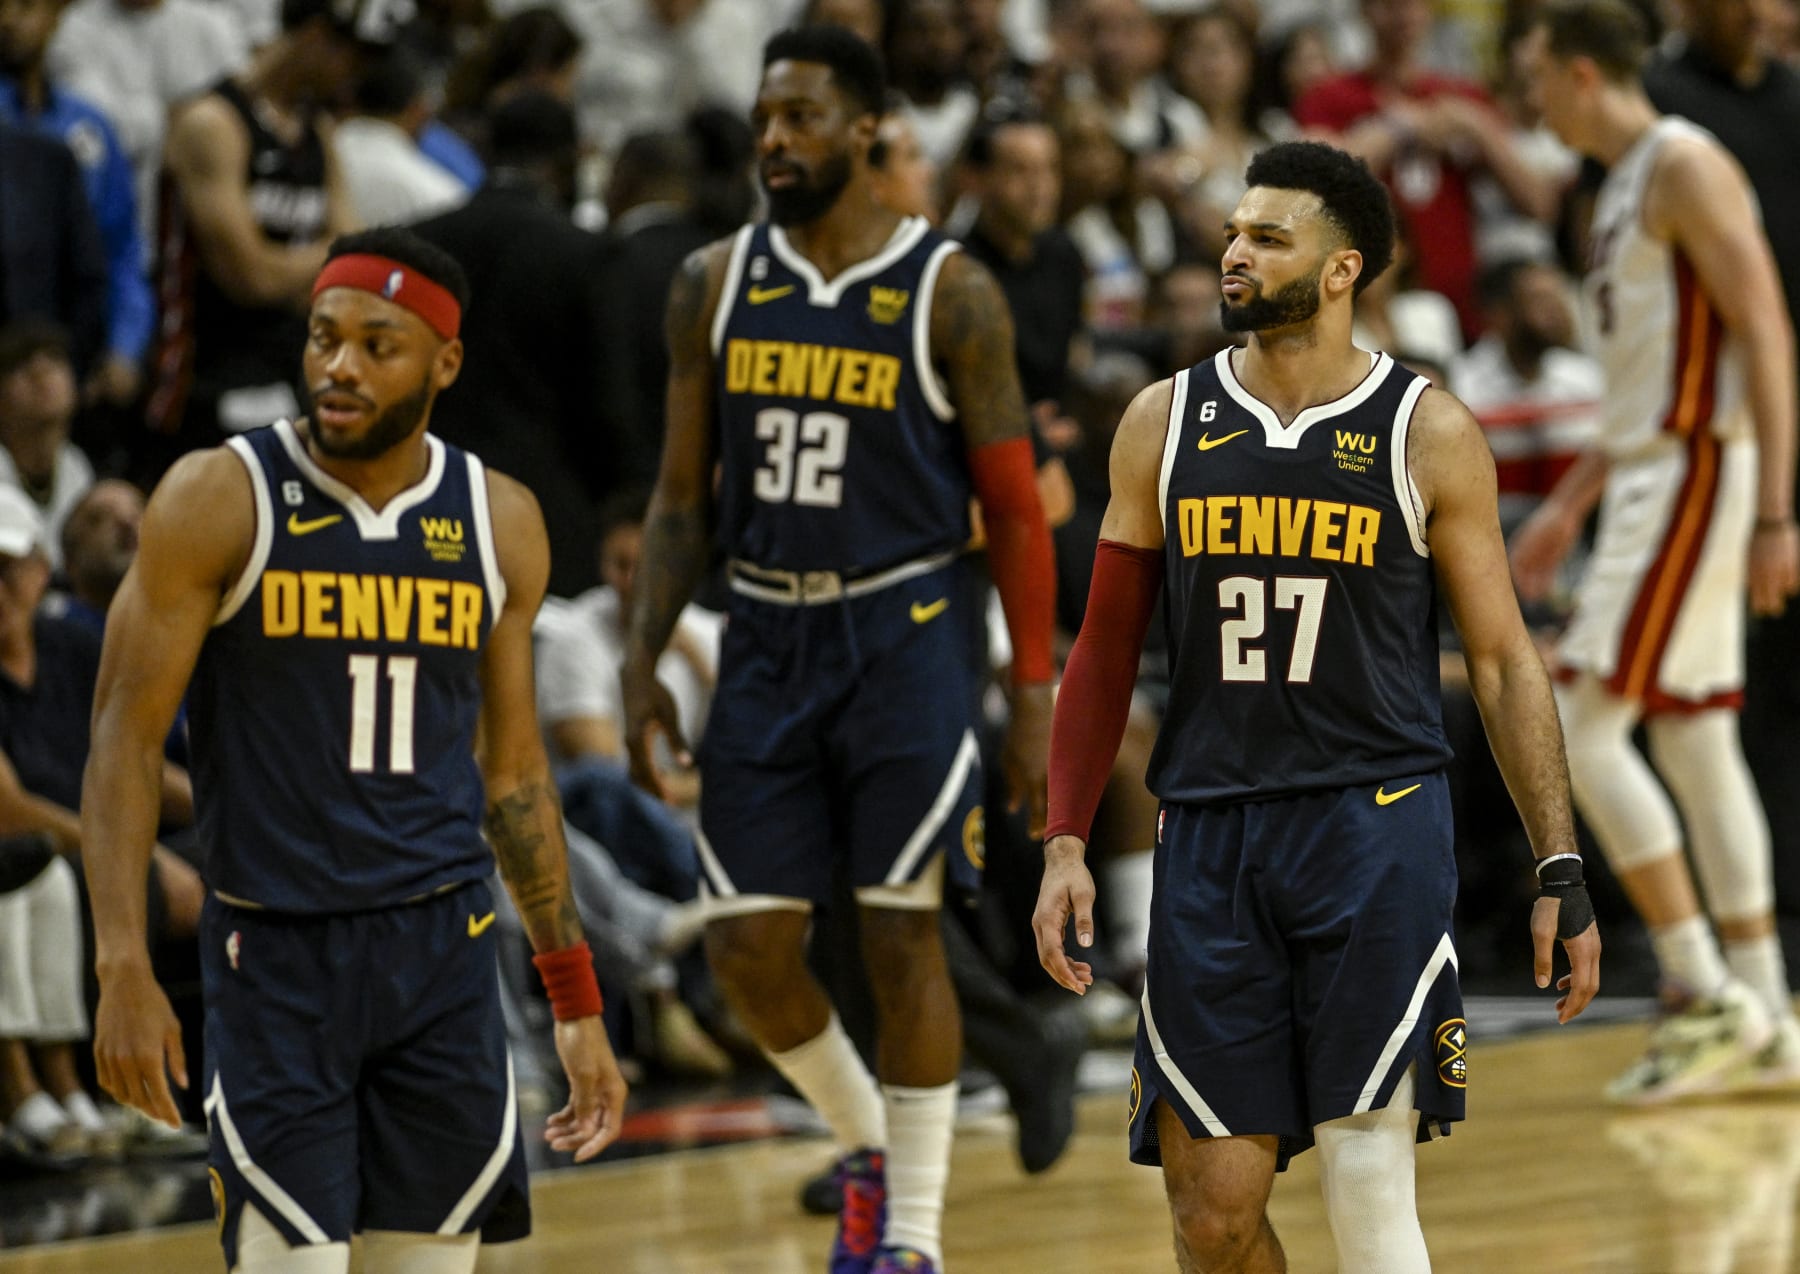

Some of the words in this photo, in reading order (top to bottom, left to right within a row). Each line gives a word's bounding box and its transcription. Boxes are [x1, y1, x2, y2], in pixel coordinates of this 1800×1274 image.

[726, 337, 902, 411] DENVER
[1200, 401, 1217, 422] 6
[754, 407, 850, 509] 32
[1333, 449, 1374, 465] Western
[1335, 429, 1377, 454] WU
[1338, 460, 1366, 473] Union
[282, 480, 304, 506] 6
[420, 516, 464, 542] WU
[1178, 495, 1382, 567] DENVER
[262, 569, 484, 650] DENVER
[1218, 575, 1329, 684] 27
[348, 653, 418, 774] 11
